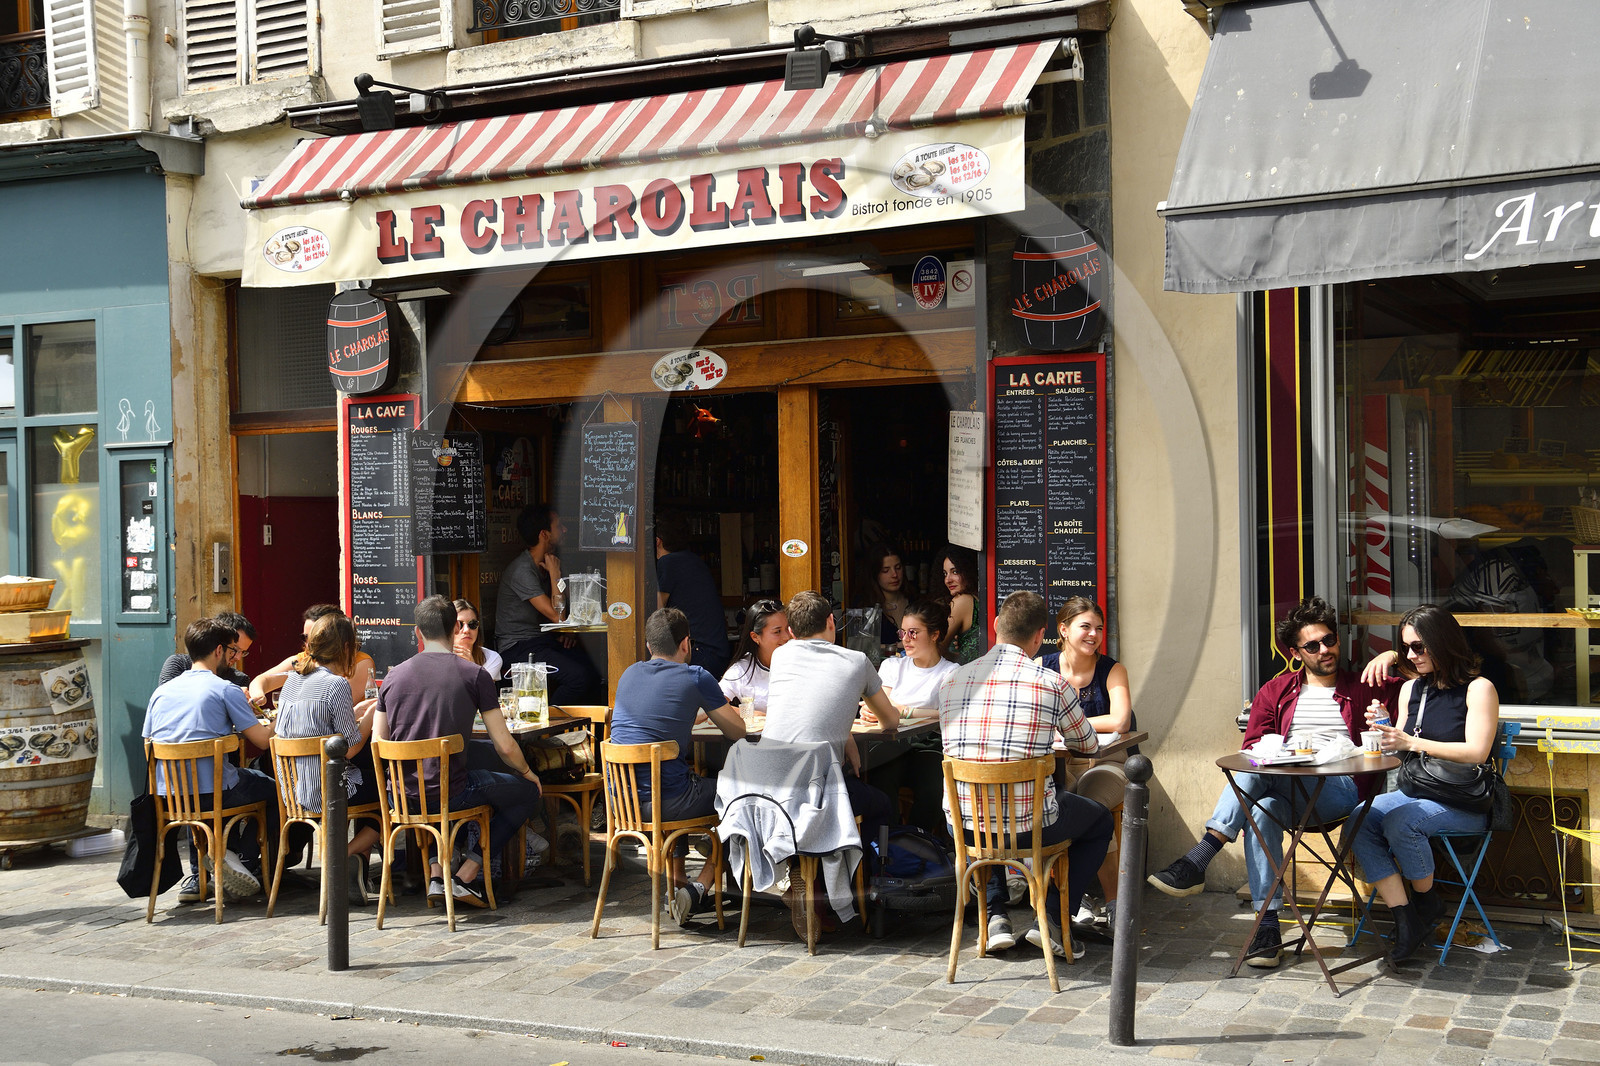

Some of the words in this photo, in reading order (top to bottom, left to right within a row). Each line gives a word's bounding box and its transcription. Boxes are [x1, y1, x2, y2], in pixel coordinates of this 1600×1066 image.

[920, 150, 938, 162] TOUTE
[938, 145, 956, 156] HEURE
[948, 155, 959, 166] les
[950, 164, 960, 176] les
[952, 174, 962, 185] les
[852, 199, 888, 216] Bistrot
[936, 196, 954, 206] en
[960, 188, 993, 204] 1905
[376, 205, 445, 265] LE
[460, 157, 848, 254] CHAROLAIS
[920, 274, 938, 282] LICENCE
[924, 284, 936, 297] IV
[1014, 293, 1033, 312] LE
[1034, 257, 1101, 302] CHAROLAIS
[330, 349, 342, 364] LE
[343, 328, 390, 358] CHAROLAIS
[714, 368, 723, 378] 12
[1010, 372, 1031, 388] LA
[1034, 371, 1082, 386] CARTE
[1006, 388, 1034, 396] ENTRÉES
[358, 406, 374, 418] LA
[376, 406, 406, 418] CAVE
[350, 424, 378, 434] ROUGES
[951, 416, 956, 428] LE
[956, 416, 980, 430] CHAROLAIS
[352, 508, 384, 520] BLANCS
[1064, 518, 1083, 527] BOÎTE
[1052, 578, 1080, 587] HUÎTRES
[354, 614, 401, 626] CHAMPAGNE
